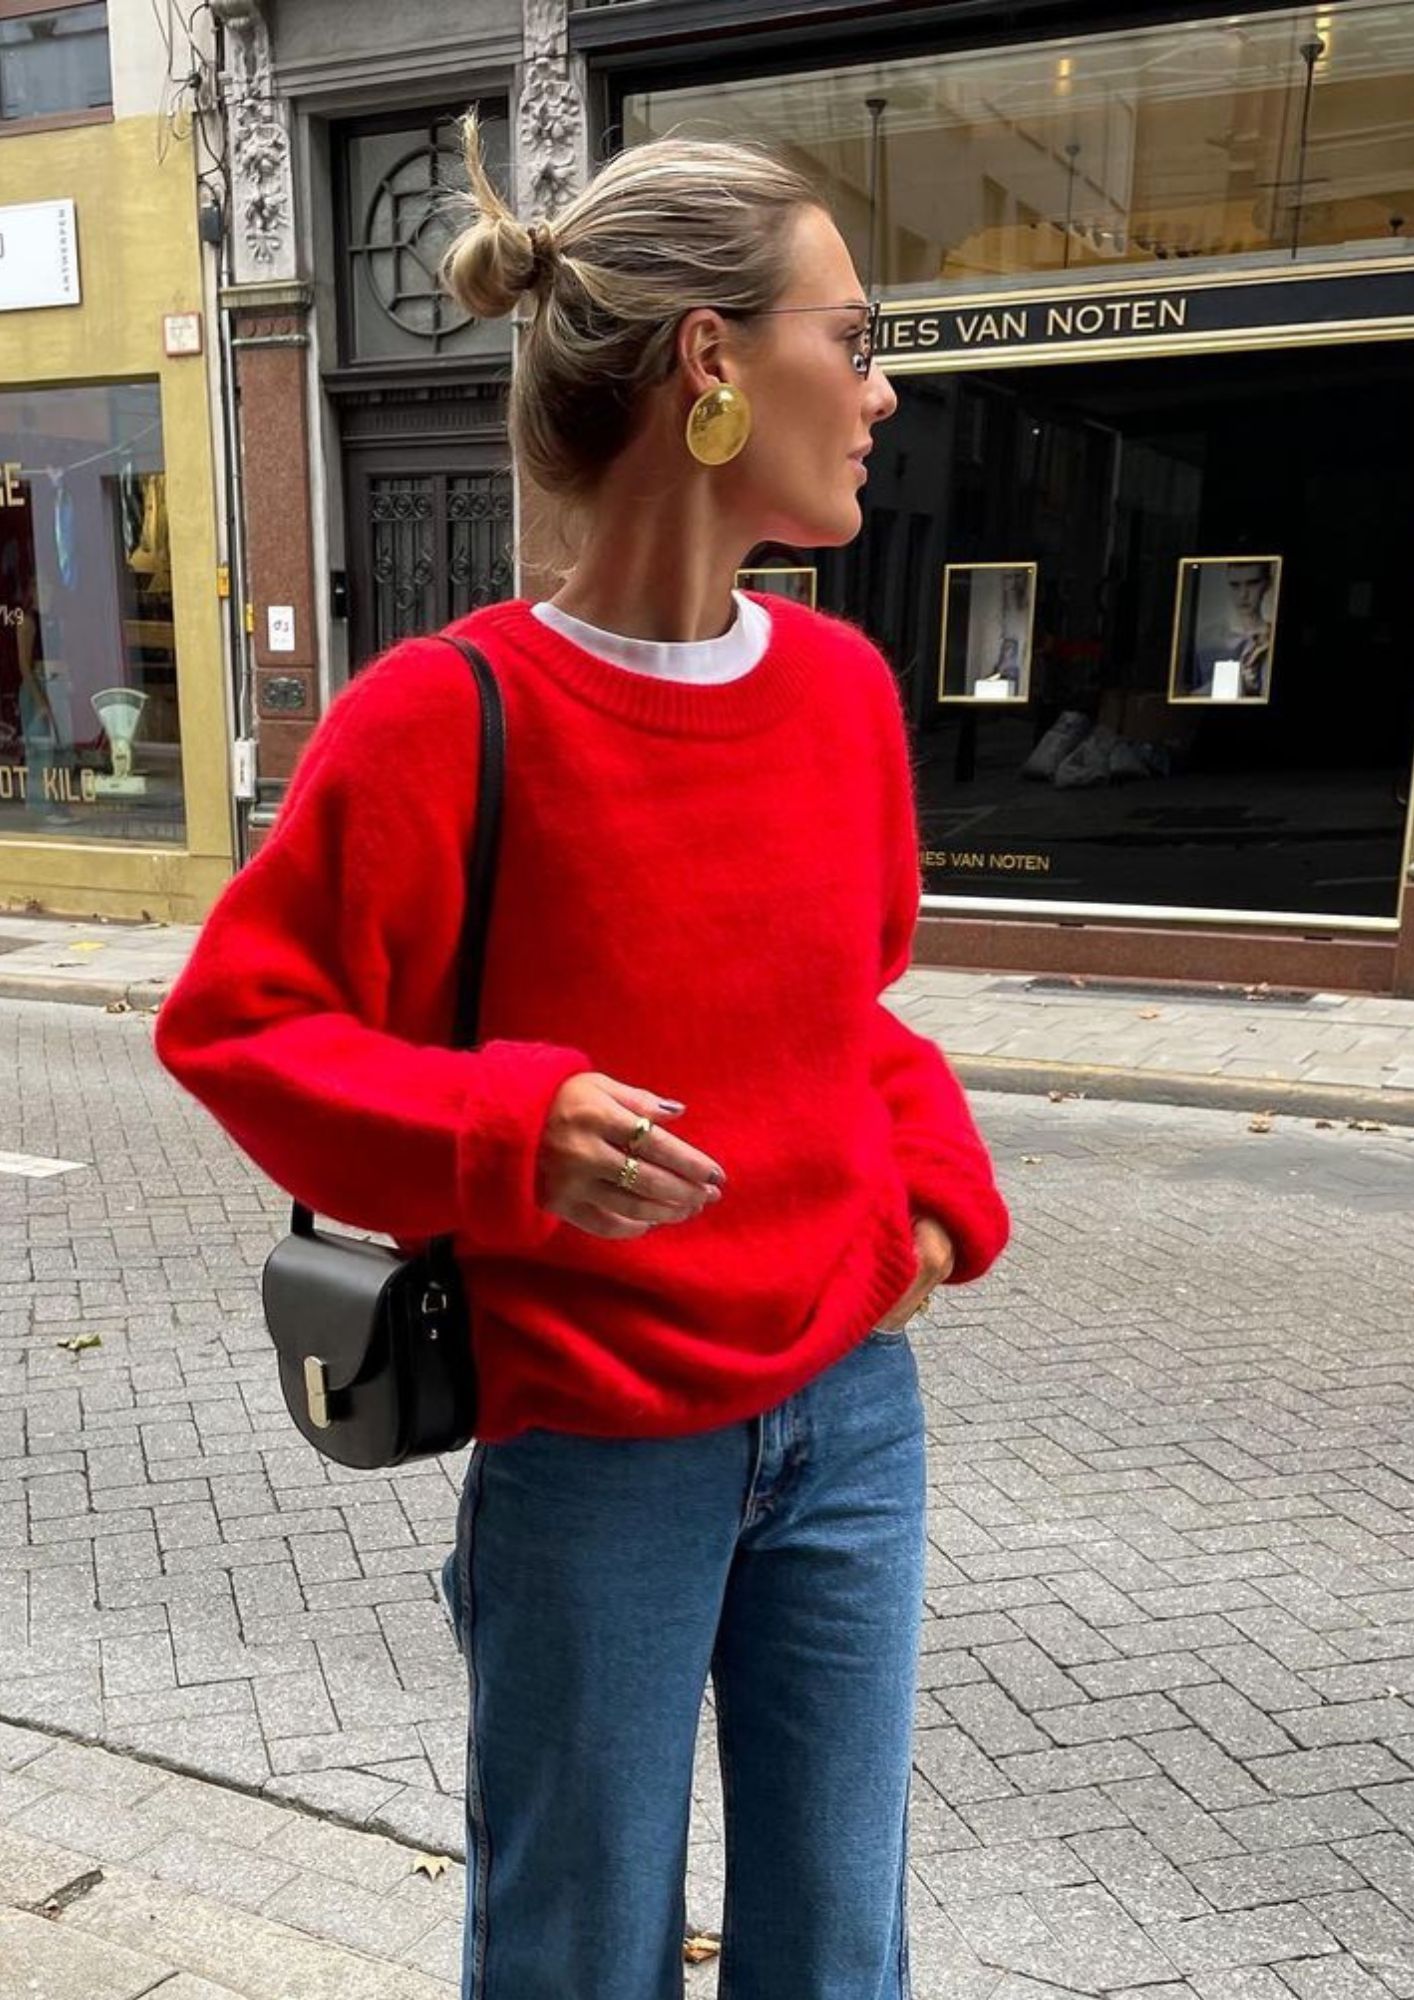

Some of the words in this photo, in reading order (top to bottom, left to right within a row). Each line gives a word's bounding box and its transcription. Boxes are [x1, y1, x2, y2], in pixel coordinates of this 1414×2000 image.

[874, 318, 940, 349] IES
[955, 311, 1027, 343] VAN
[1047, 298, 1187, 336] NOTEN
[0, 462, 25, 507] E
[43, 767, 96, 802] KILO
[950, 852, 985, 868] VAN
[989, 853, 1050, 871] NOTEN
